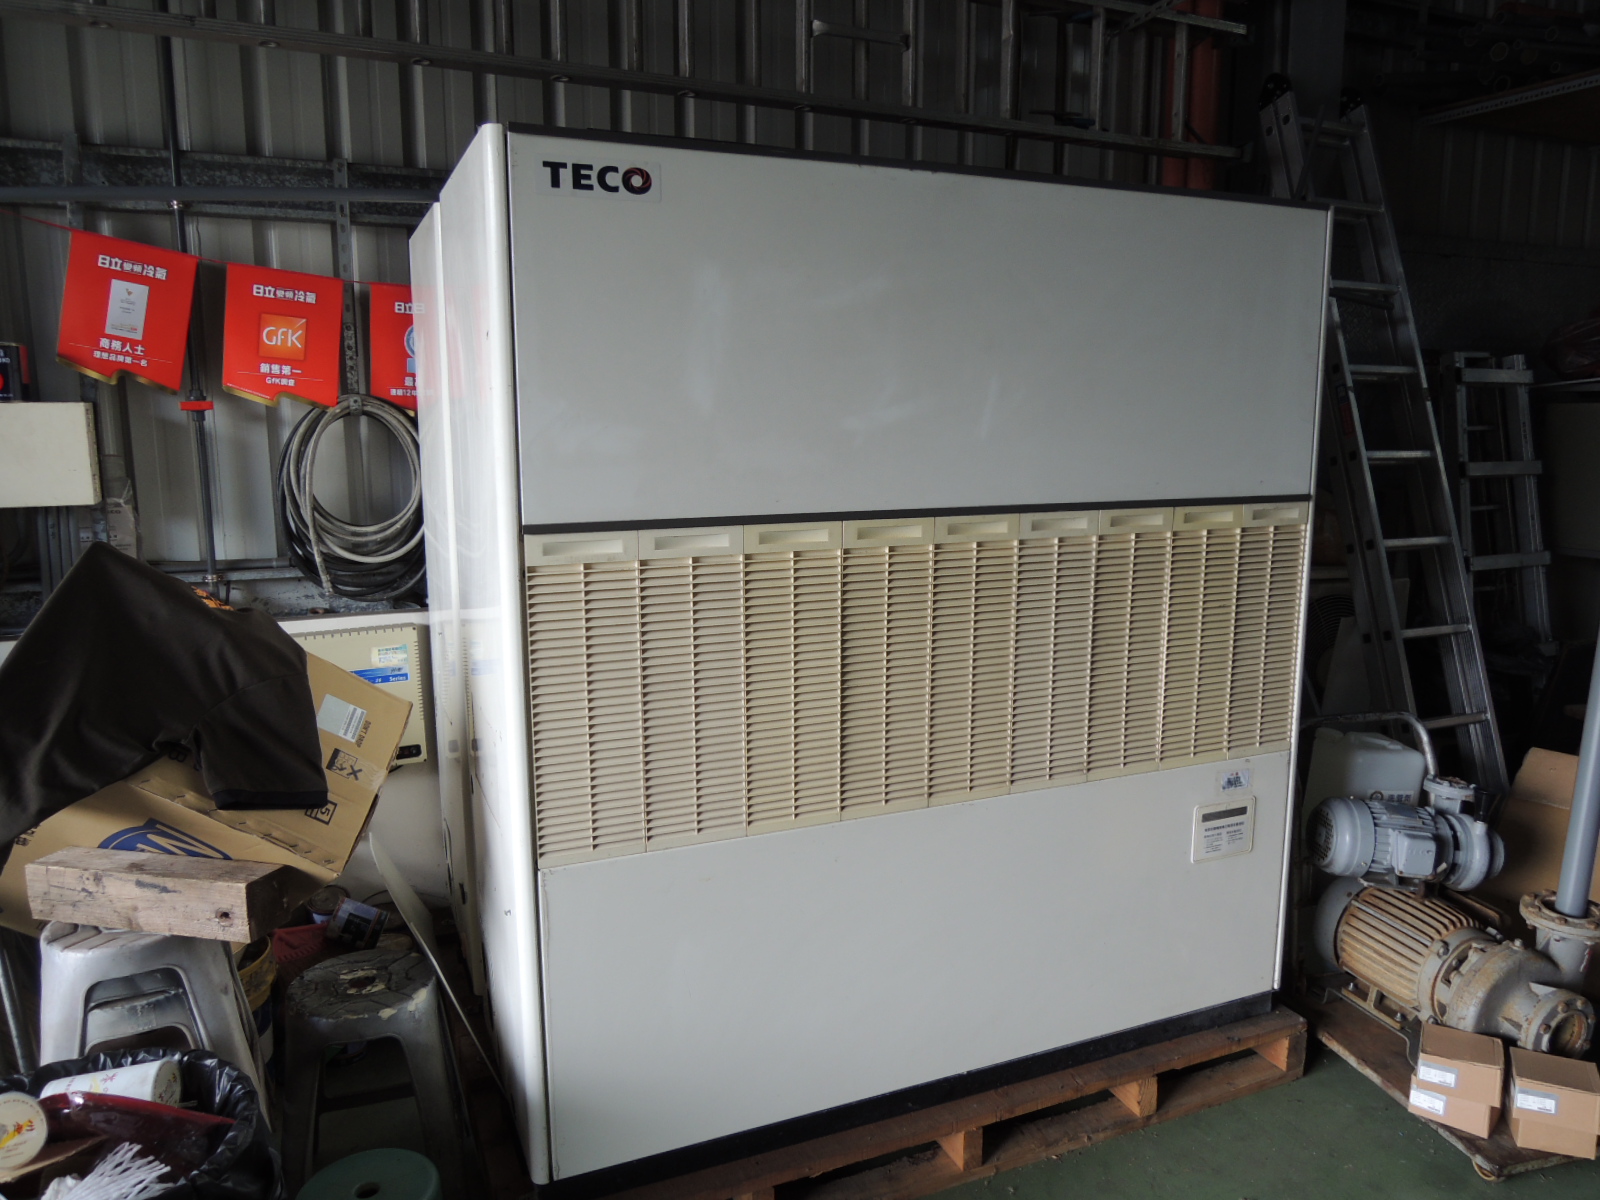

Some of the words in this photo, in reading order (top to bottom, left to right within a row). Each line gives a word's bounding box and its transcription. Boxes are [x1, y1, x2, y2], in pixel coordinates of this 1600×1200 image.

[542, 160, 652, 195] TECO
[97, 254, 168, 280] 日立變頻冷氣
[252, 284, 316, 304] 日立變頻冷氣
[99, 337, 146, 355] 商務人士
[262, 326, 303, 348] GfK
[260, 363, 302, 376] 銷售第一
